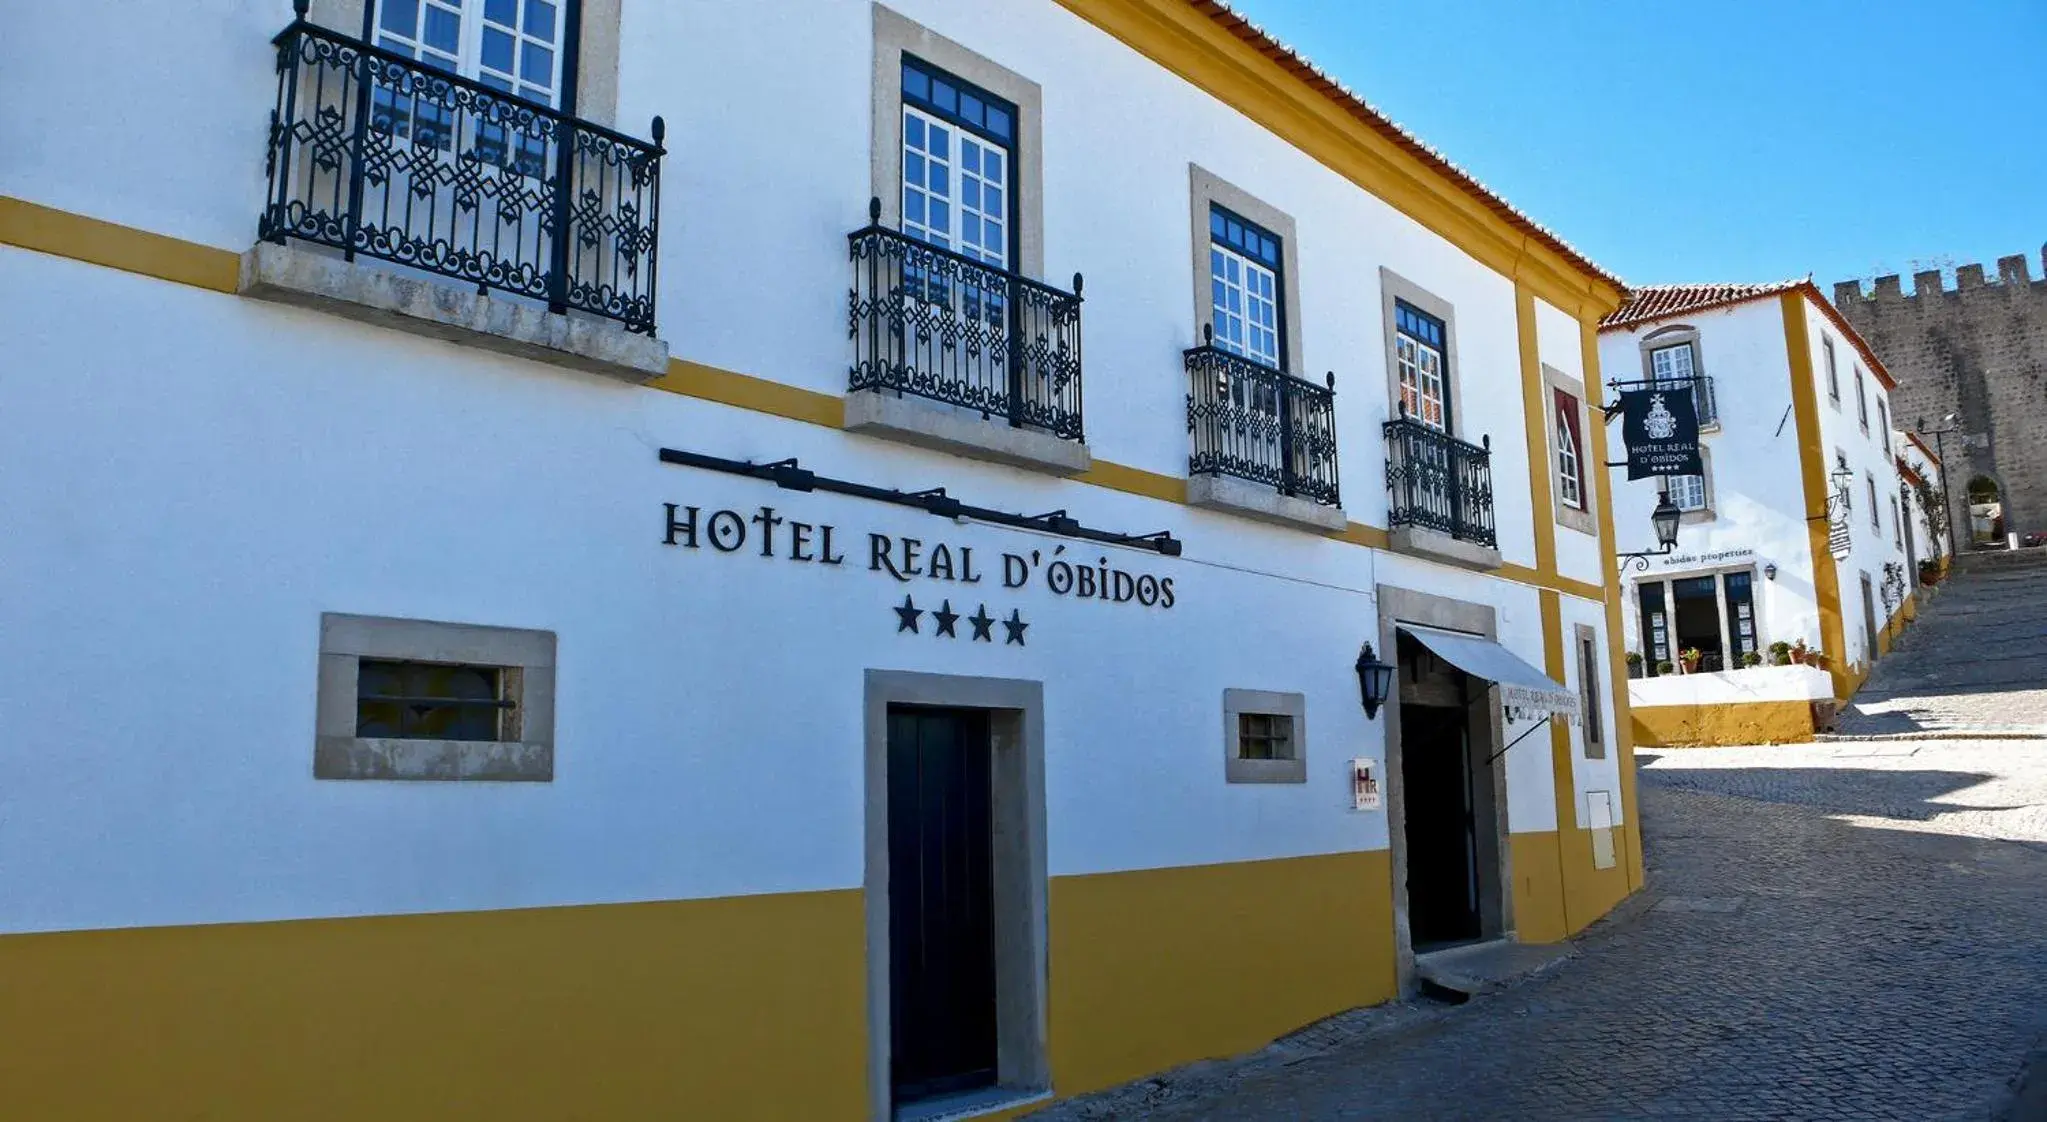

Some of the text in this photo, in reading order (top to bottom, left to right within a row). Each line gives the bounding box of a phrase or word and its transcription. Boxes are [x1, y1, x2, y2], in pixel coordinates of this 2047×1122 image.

[1632, 442, 1695, 454] HOTEL REAL
[662, 503, 1175, 608] HOTEL REAL D'ÓBIDOS
[1701, 549, 1753, 563] properties
